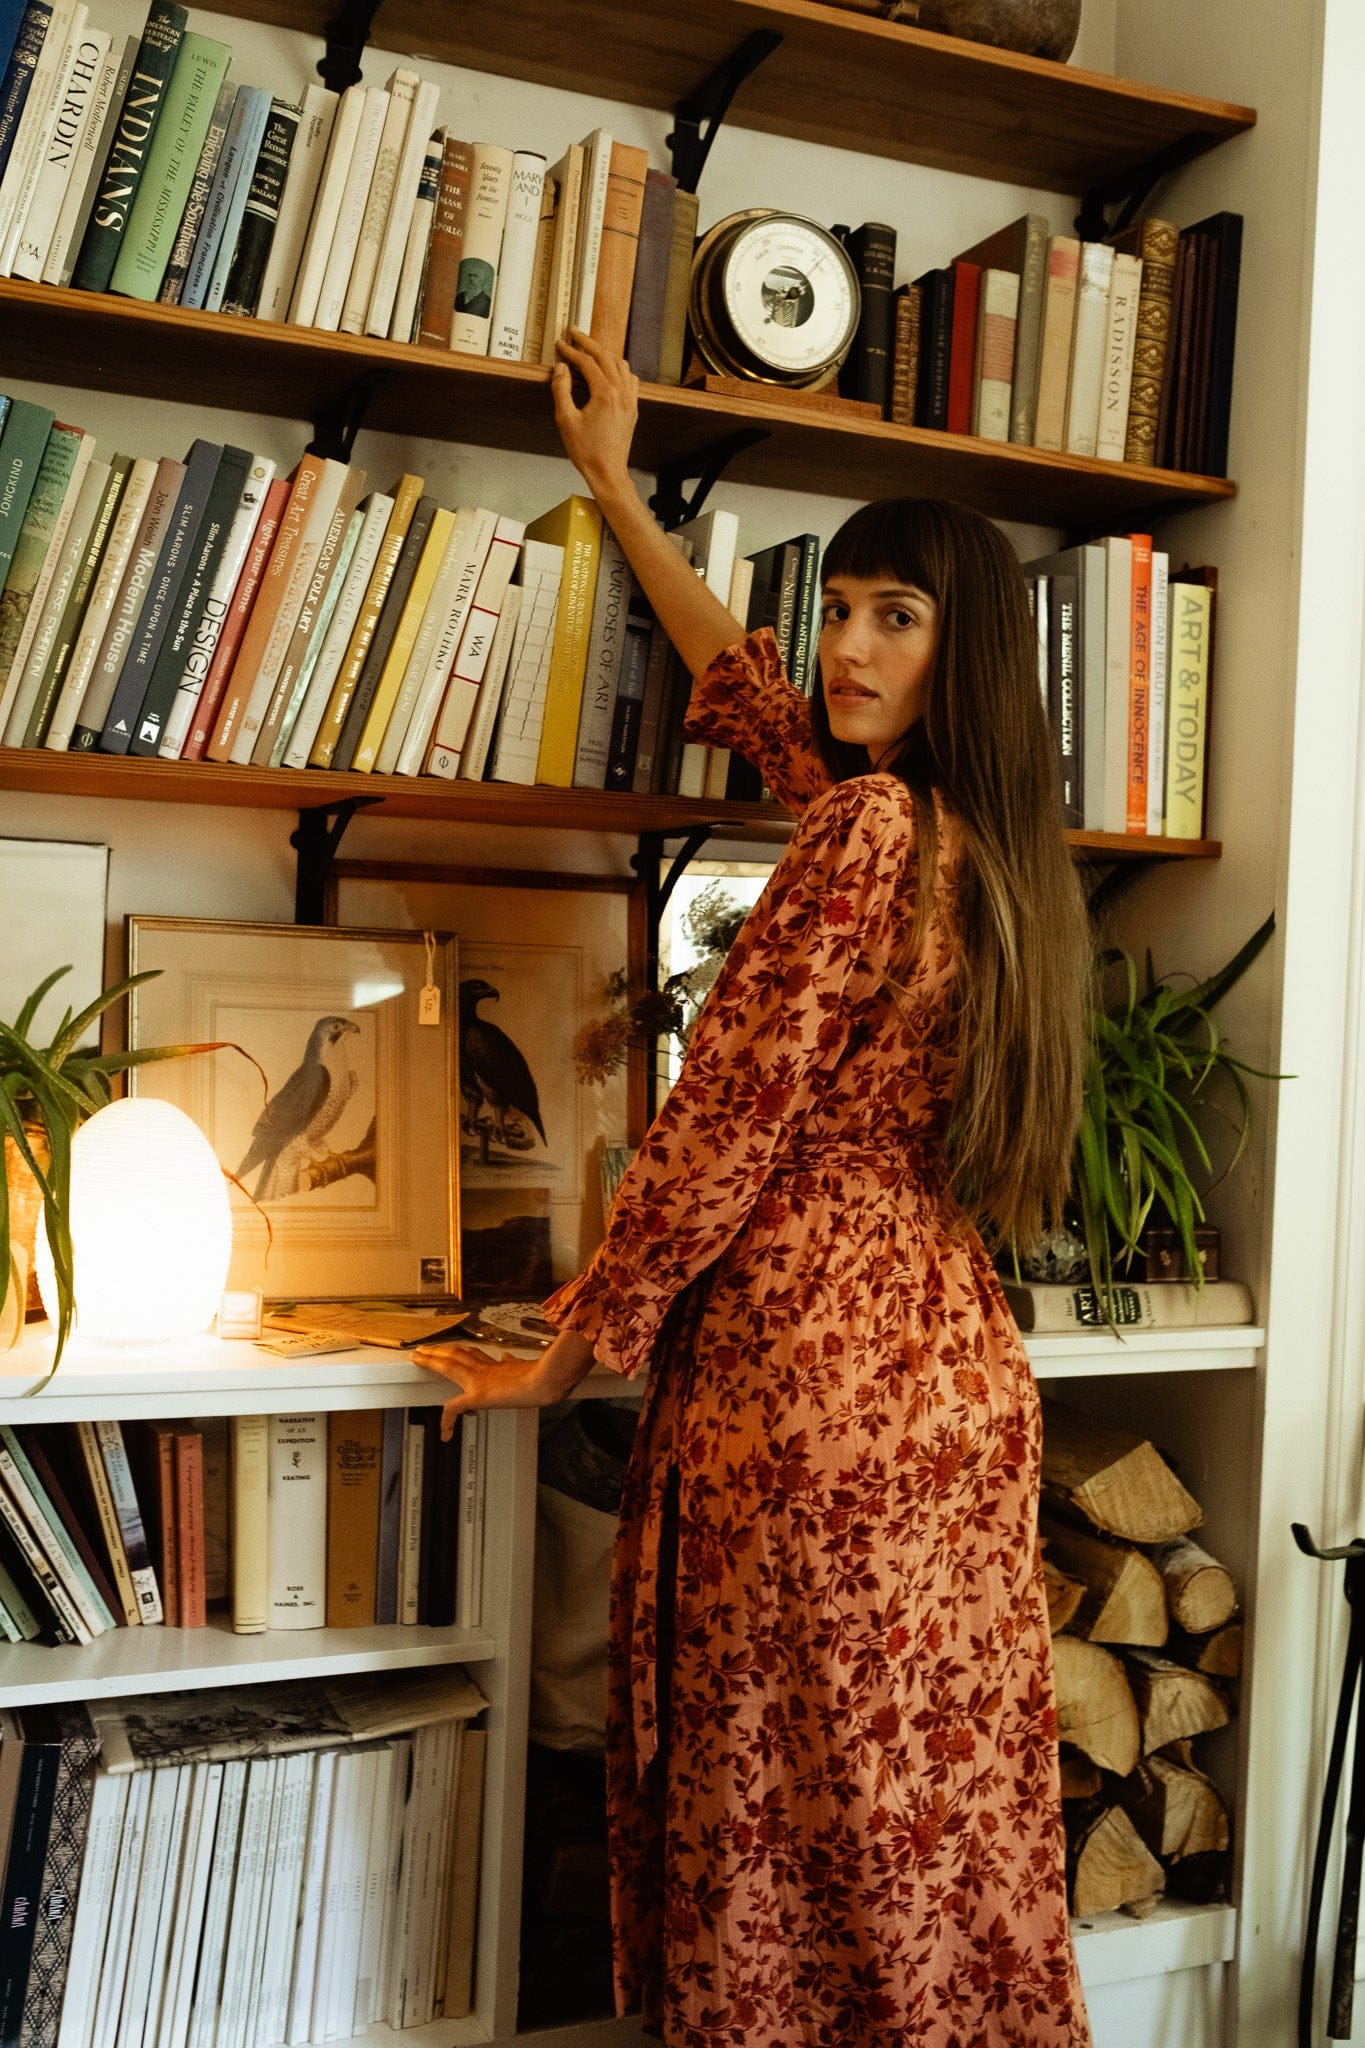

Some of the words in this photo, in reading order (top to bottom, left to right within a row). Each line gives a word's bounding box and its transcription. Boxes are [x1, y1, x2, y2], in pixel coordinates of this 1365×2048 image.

[192, 54, 217, 68] LEWIS
[8, 66, 28, 112] Byzantine
[98, 63, 114, 99] Robert
[116, 67, 129, 96] CALDER
[192, 67, 208, 92] THE
[47, 41, 100, 169] CHARDIN
[179, 93, 200, 136] VALLEY
[84, 99, 104, 150] Motherwell
[267, 131, 288, 146] Great
[274, 122, 286, 134] The
[94, 71, 164, 232] INDIANS
[174, 137, 187, 154] OF
[198, 123, 223, 179] Enjoying
[165, 157, 181, 182] THE
[222, 145, 237, 178] Langue
[480, 161, 502, 174] Seventy
[192, 180, 208, 203] the
[218, 179, 226, 189] et
[444, 184, 462, 196] THE
[482, 173, 498, 184] Years
[513, 170, 544, 186] MARY
[515, 182, 540, 197] AND
[207, 191, 225, 240] Civilisation
[440, 196, 462, 210] MASK
[444, 211, 455, 220] OF
[594, 198, 603, 220] AND
[146, 184, 174, 254] MISSISSIPPI
[174, 199, 202, 268] Southwest
[504, 326, 519, 336] ROSS
[498, 341, 520, 352] HAINES
[1105, 295, 1128, 411] RADISSON
[0, 458, 23, 517] JONGKIND
[296, 468, 317, 501] Great
[152, 489, 169, 516] John
[179, 502, 194, 528] SLIM
[289, 501, 306, 523] Art
[59, 509, 71, 528] SAM
[114, 502, 137, 548] NEW
[143, 515, 161, 547] Welsh
[207, 521, 221, 543] Slim
[257, 517, 277, 547] light
[68, 534, 83, 560] THE
[166, 528, 187, 568] AARONS
[272, 523, 299, 577] Treasures
[319, 507, 347, 571] AMERICA'S
[582, 544, 591, 557] THE
[807, 541, 815, 553] THE
[198, 540, 215, 572] Aarons
[247, 547, 266, 579] your
[570, 554, 581, 579] YEARS
[52, 562, 74, 611] CHINESE
[95, 552, 123, 610] IMAGE
[124, 546, 156, 616] Modern
[156, 575, 172, 602] ONCE
[192, 578, 203, 589] A
[307, 572, 326, 605] FOLK
[455, 561, 477, 605] MARK
[569, 579, 578, 590] OF
[578, 559, 591, 596] NATIONAL
[186, 586, 200, 611] Place
[238, 577, 258, 614] home
[604, 559, 625, 643] PURPOSES
[782, 581, 795, 611] NEW
[800, 584, 811, 612] ANATOMY
[1135, 584, 1146, 613] THE
[1155, 568, 1166, 646] AMERICAN
[147, 602, 163, 630] UPON
[177, 618, 190, 635] the
[298, 605, 315, 634] ART
[564, 590, 578, 634] ADVENTURE
[779, 611, 791, 637] OLD
[800, 613, 807, 622] OF
[1061, 602, 1073, 630] THE
[143, 631, 154, 641] A
[172, 633, 185, 652] Sun
[435, 607, 462, 671] ROTHKO
[796, 622, 809, 664] ANTIQUE
[1135, 621, 1146, 652] AGE
[1182, 594, 1202, 663] ART
[31, 615, 57, 676] EXHIBITION
[104, 617, 134, 676] House
[137, 641, 151, 665] TIME
[180, 598, 228, 696] DESIGN
[468, 635, 486, 657] WA
[600, 648, 614, 672] OF
[1061, 632, 1073, 676] MENIL
[1134, 659, 1145, 681] OF
[1153, 651, 1164, 707] BEAUTY
[1180, 668, 1200, 692] &
[595, 674, 611, 713] ART
[1061, 678, 1074, 755] COLLECTION
[1133, 688, 1145, 784] INNOCENCE
[1176, 696, 1199, 804] TODAY
[1083, 1292, 1097, 1322] ART
[341, 1452, 364, 1462] Book
[366, 1452, 376, 1462] of
[344, 1440, 360, 1448] The
[282, 1474, 310, 1482] KEATING
[465, 1480, 475, 1490] by
[29, 1512, 51, 1541] Journal
[45, 1537, 56, 1548] of
[51, 1552, 74, 1581] Trapper
[11, 1896, 30, 1929] CABANA
[48, 1890, 66, 1920] CABANA
